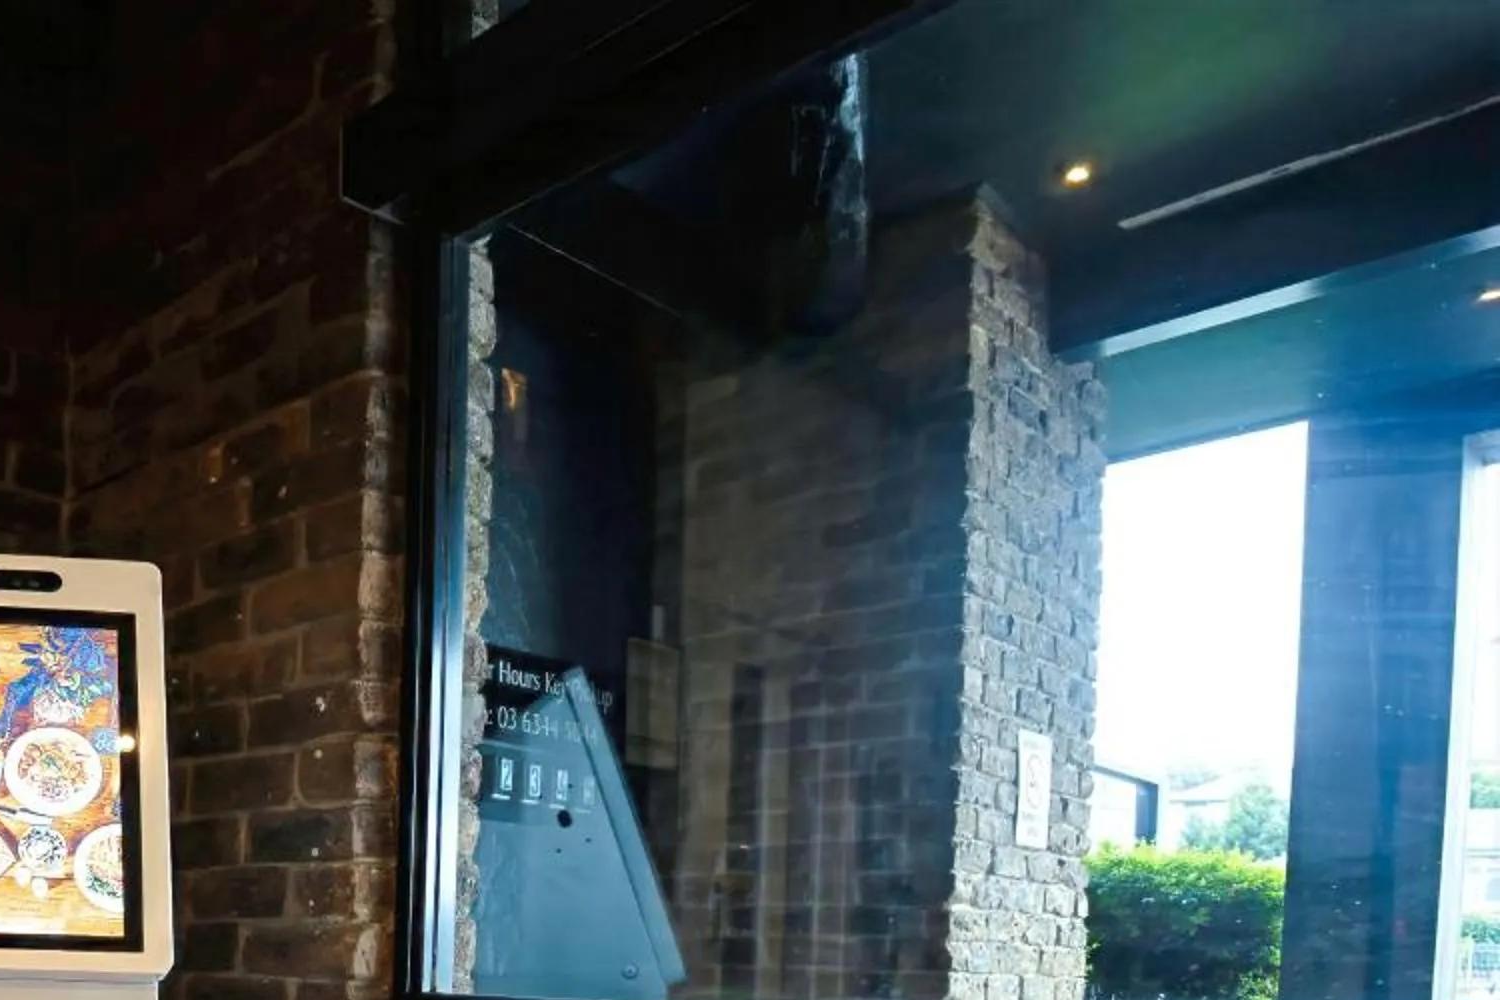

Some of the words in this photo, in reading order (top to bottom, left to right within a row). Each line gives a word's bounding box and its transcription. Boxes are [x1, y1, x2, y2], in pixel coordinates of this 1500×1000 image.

[499, 660, 541, 690] Hours
[498, 705, 517, 729] 03
[530, 766, 540, 796] 3
